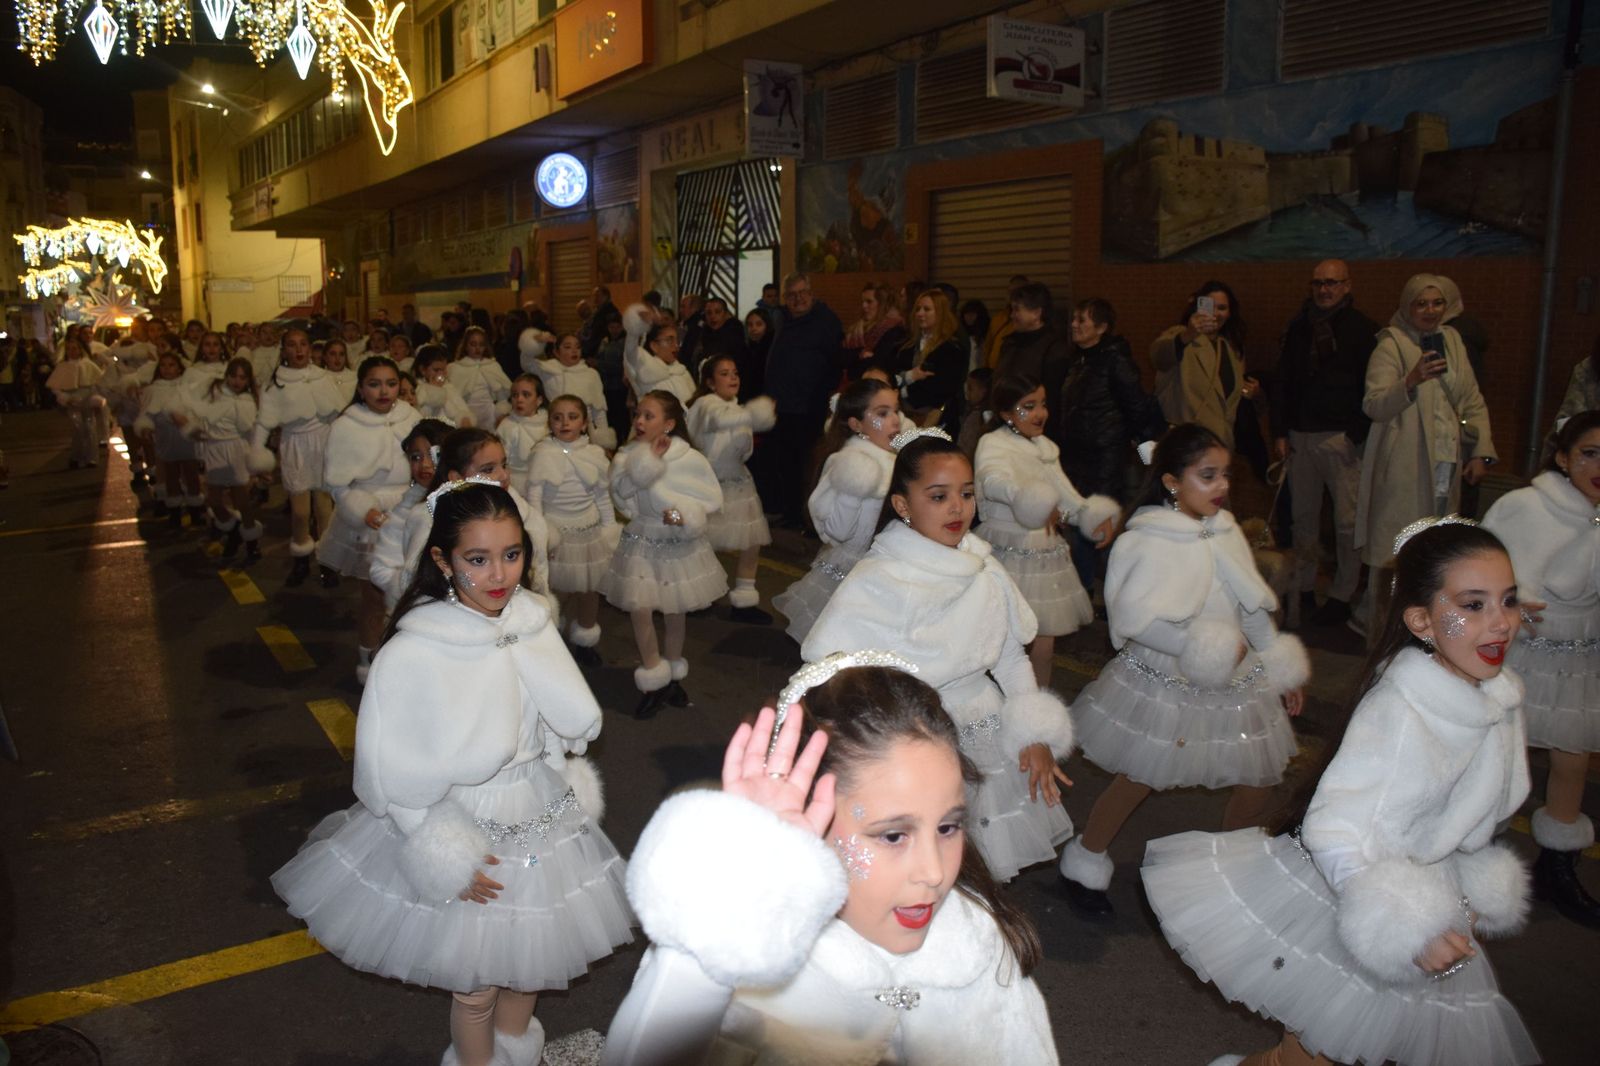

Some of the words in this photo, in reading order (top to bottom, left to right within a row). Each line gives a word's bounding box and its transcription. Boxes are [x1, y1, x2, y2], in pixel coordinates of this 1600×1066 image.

[1005, 31, 1031, 41] JUAN
[1033, 36, 1073, 47] CARLOS
[659, 118, 720, 163] REAL
